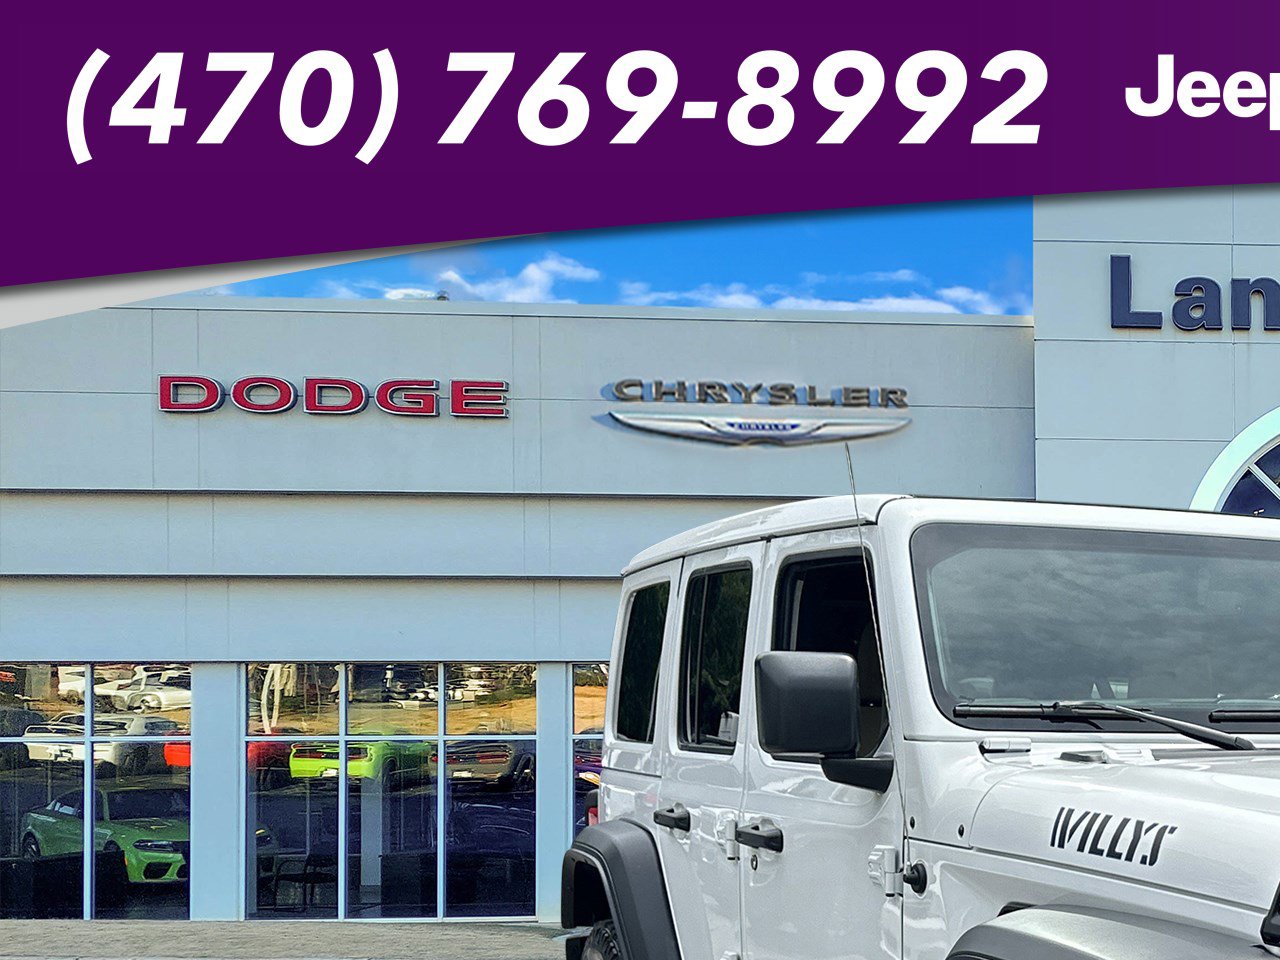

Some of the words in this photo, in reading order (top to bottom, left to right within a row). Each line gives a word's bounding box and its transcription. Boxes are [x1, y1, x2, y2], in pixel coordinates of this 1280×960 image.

[158, 374, 510, 418] DODGE
[611, 379, 909, 408] CHRYSLER
[1050, 806, 1178, 866] WILLYS
